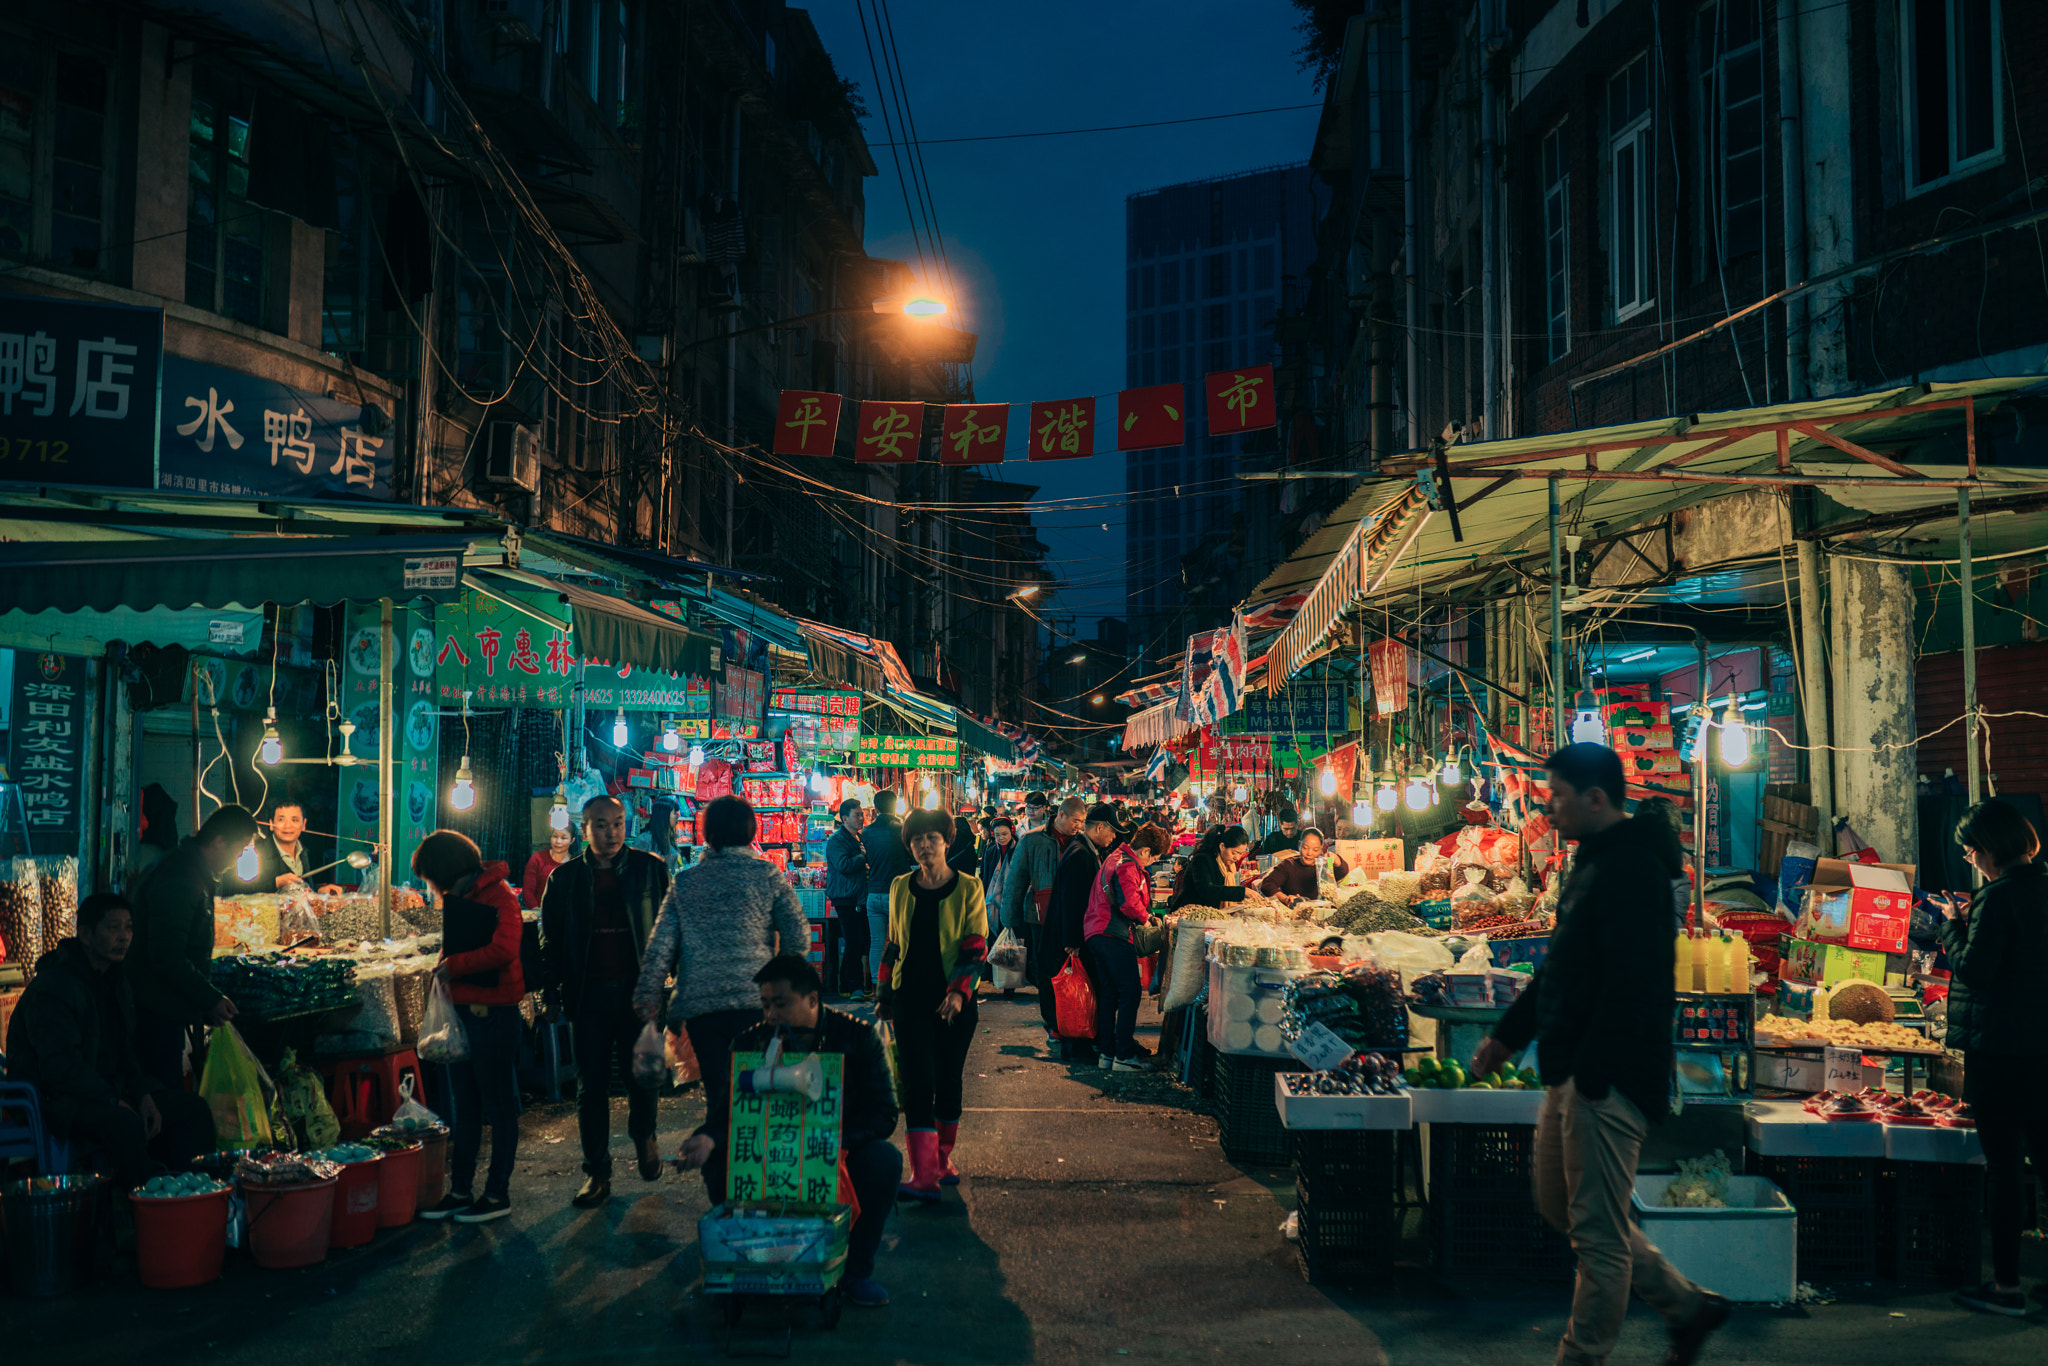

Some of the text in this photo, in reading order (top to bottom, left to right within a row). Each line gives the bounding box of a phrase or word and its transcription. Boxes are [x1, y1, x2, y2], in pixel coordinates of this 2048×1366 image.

[0, 331, 138, 420] 鸭店
[785, 374, 1264, 457] 平安和谐八市
[176, 387, 384, 489] 水鸭店
[619, 690, 685, 705] 13328400625
